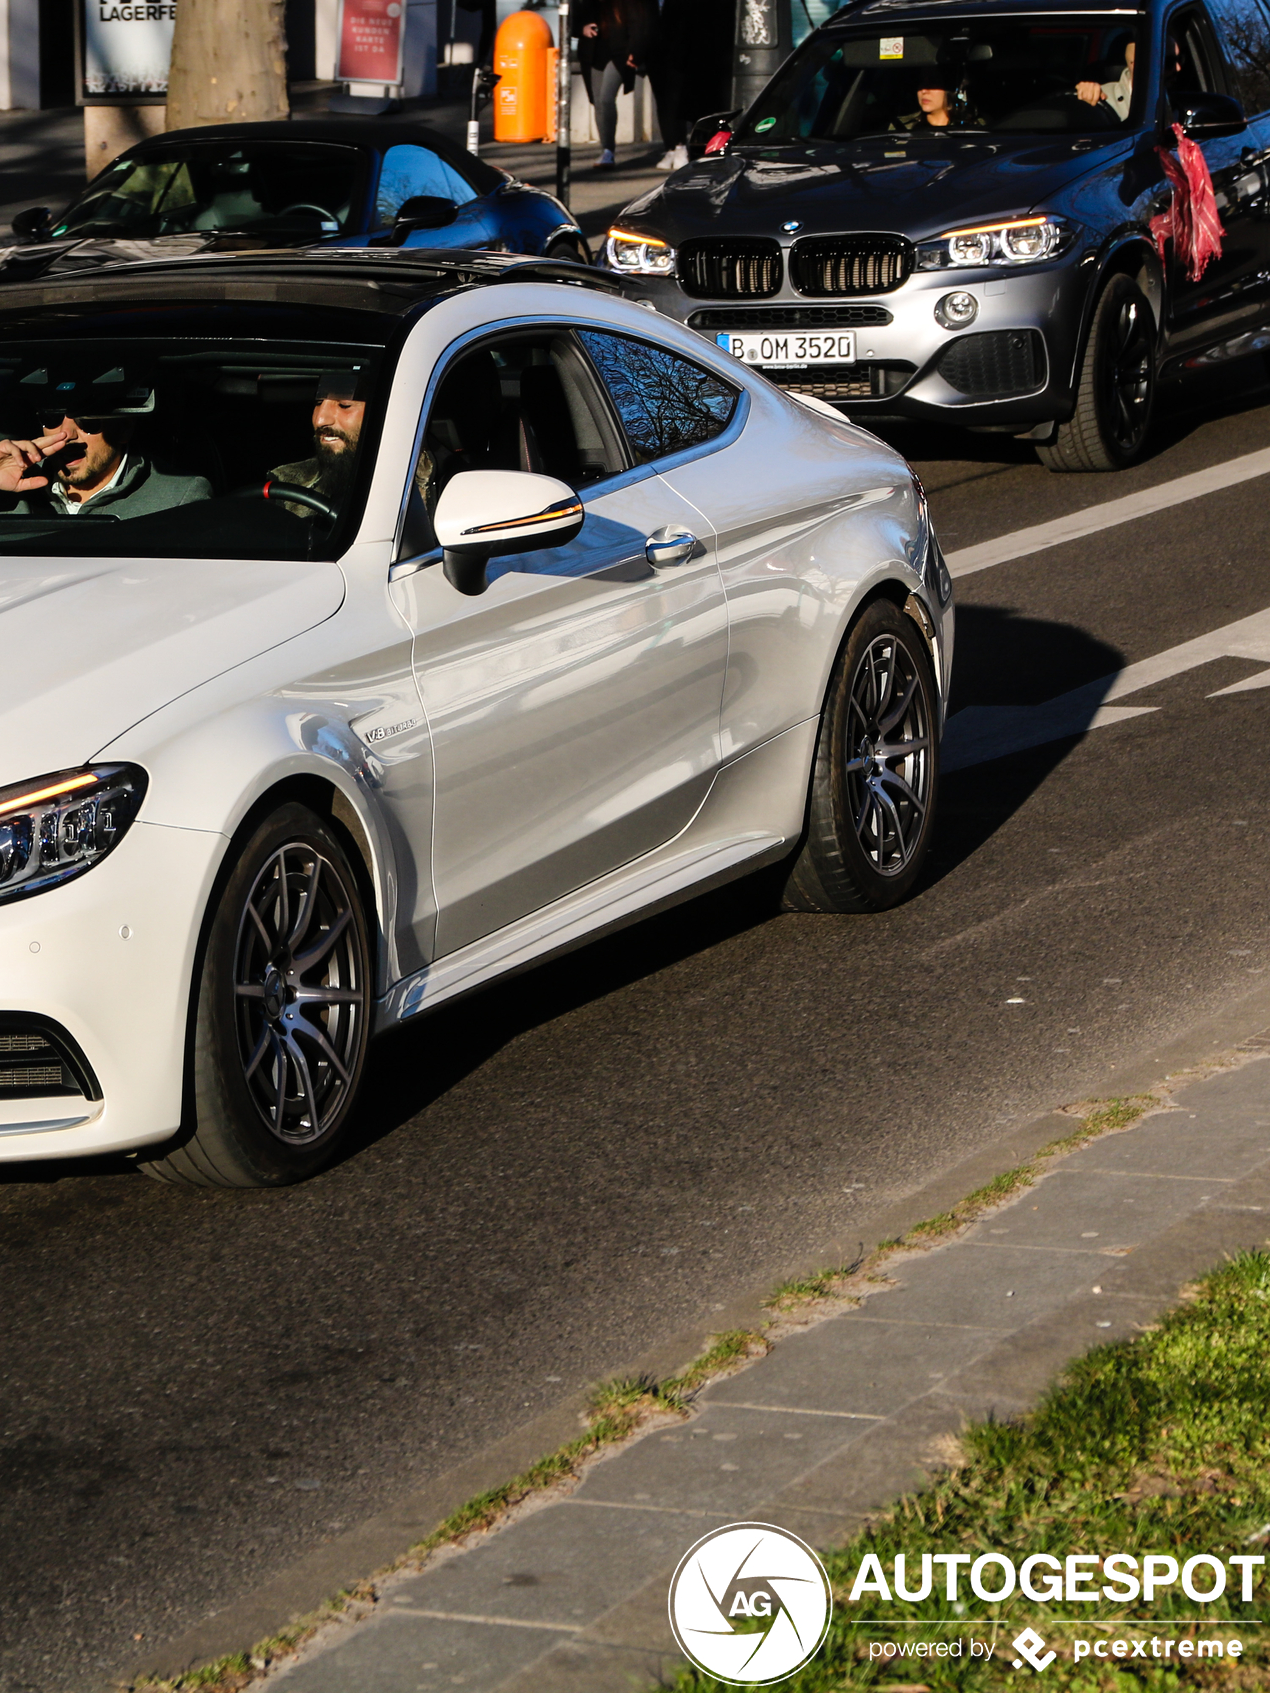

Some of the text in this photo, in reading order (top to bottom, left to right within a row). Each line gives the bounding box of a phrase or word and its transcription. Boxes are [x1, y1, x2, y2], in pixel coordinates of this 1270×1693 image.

[350, 17, 393, 26] DIE NEUE
[352, 27, 390, 35] KUNDEN
[356, 36, 385, 44] KARTE
[732, 336, 850, 359] B OM 3520
[366, 719, 417, 743] V8 BITURBO
